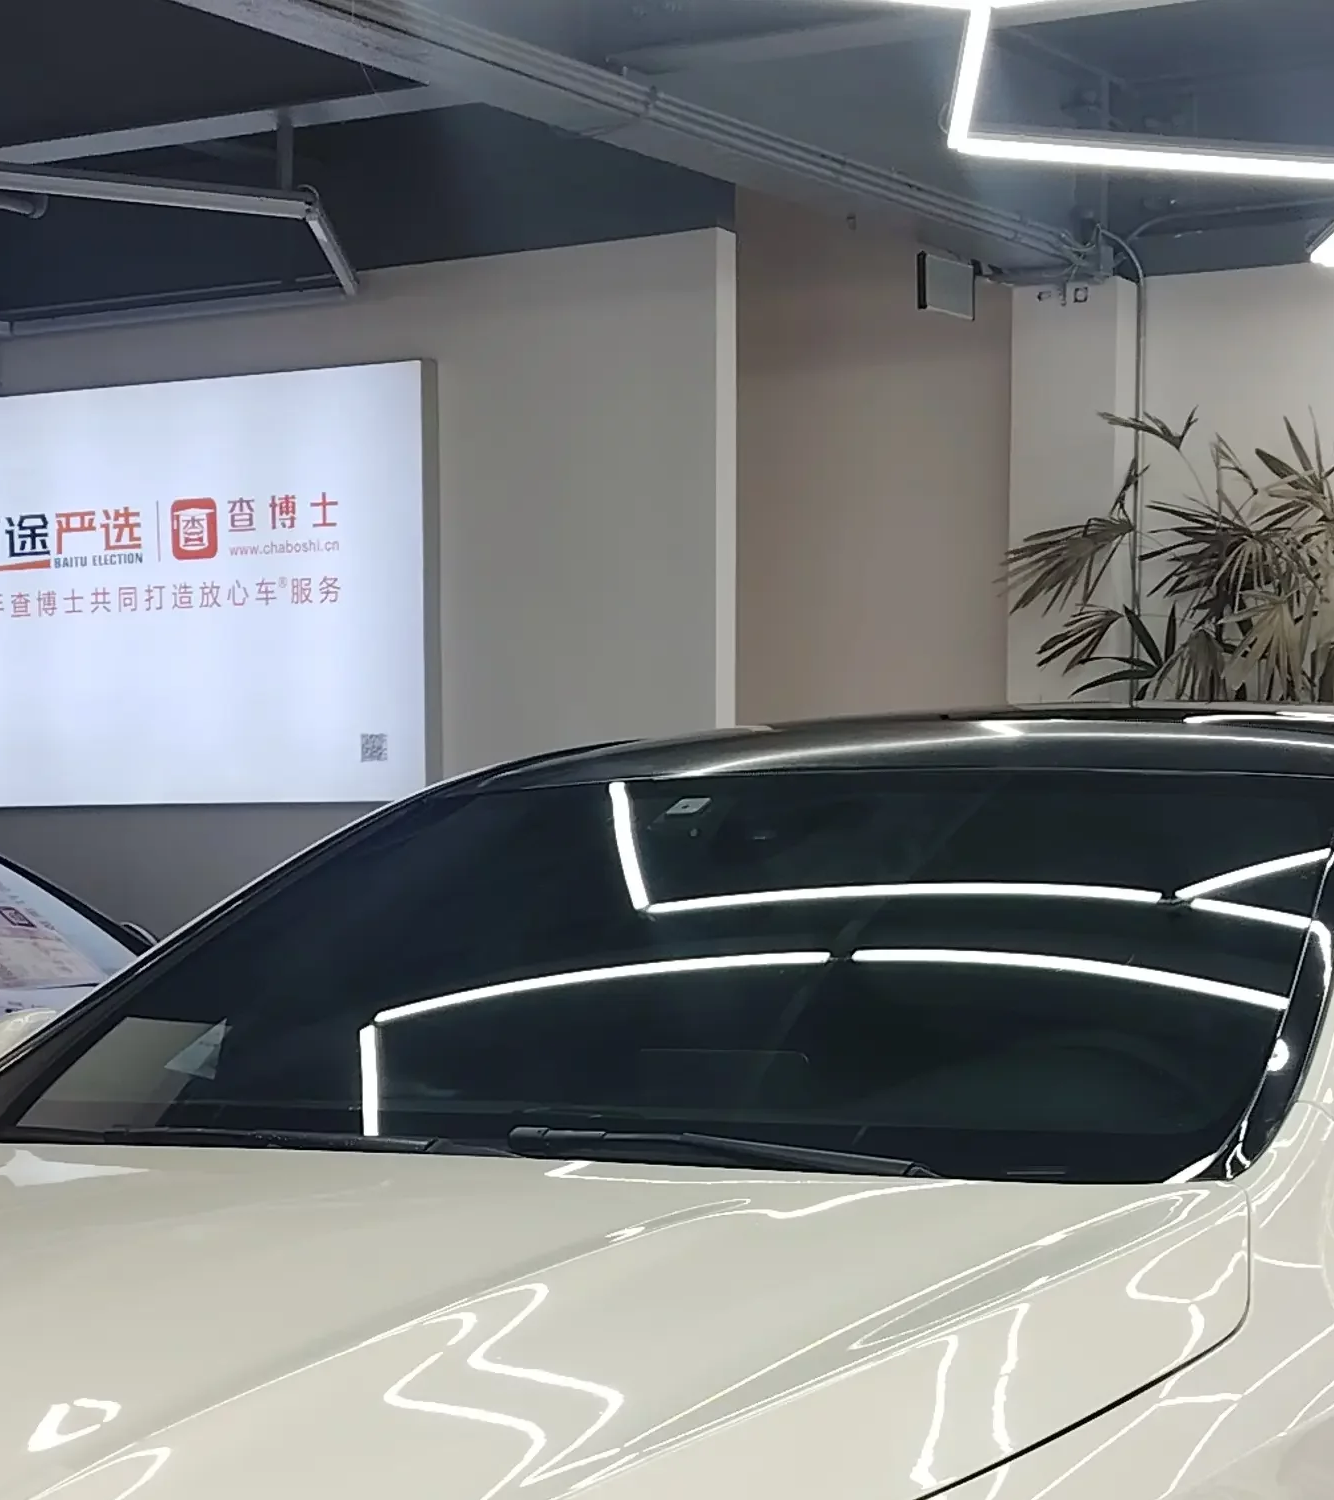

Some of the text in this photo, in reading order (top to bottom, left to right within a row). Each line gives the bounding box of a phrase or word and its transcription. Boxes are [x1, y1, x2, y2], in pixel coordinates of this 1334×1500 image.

[227, 492, 339, 532] 查博士
[228, 540, 340, 557] www.chaboshi.cn
[54, 552, 144, 569] BAITU ELECTION
